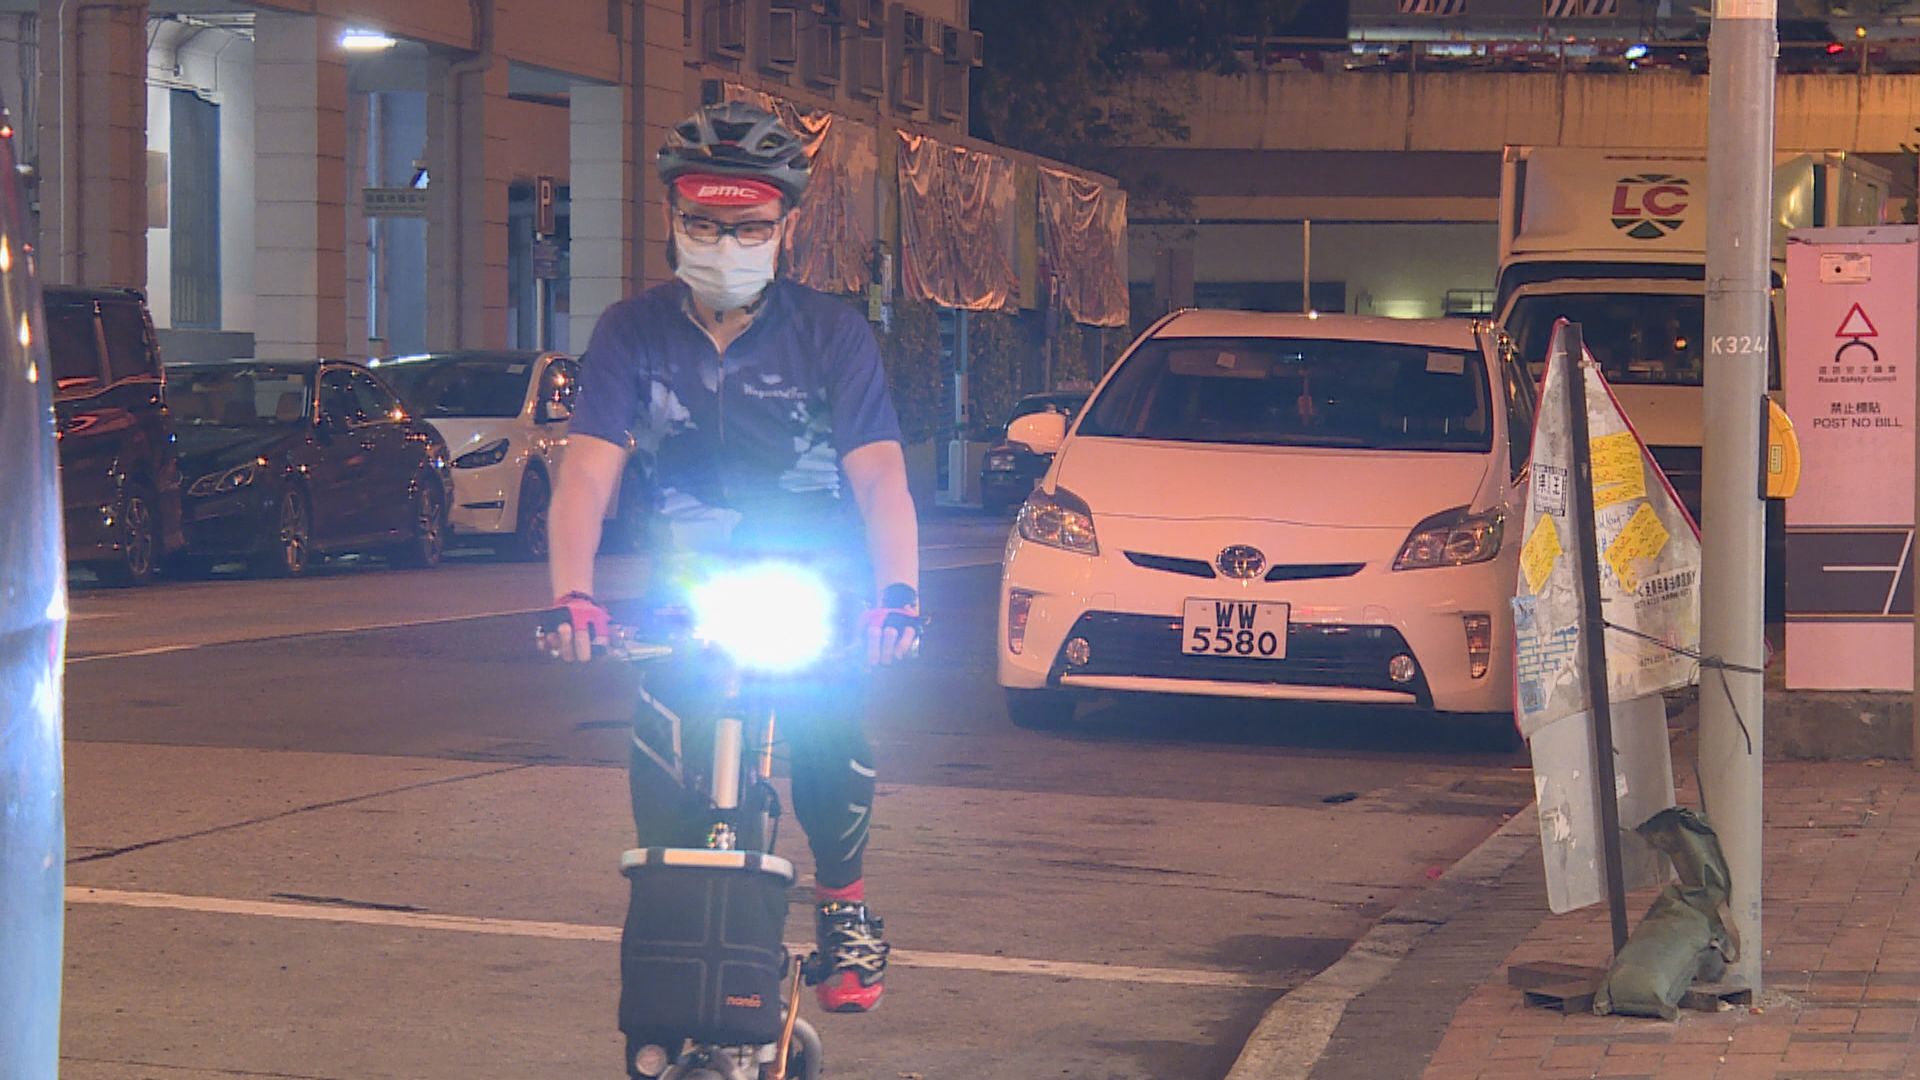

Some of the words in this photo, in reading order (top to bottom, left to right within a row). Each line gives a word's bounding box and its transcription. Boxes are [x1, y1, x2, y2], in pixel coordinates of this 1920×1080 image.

[1611, 185, 1689, 217] LC
[1818, 376, 1839, 384] Road
[1841, 376, 1866, 385] Safety
[1813, 418, 1848, 429] POST
[1851, 418, 1871, 428] NO
[1875, 417, 1904, 428] BILL
[1216, 602, 1257, 629] WW
[1191, 626, 1278, 656] 5580
